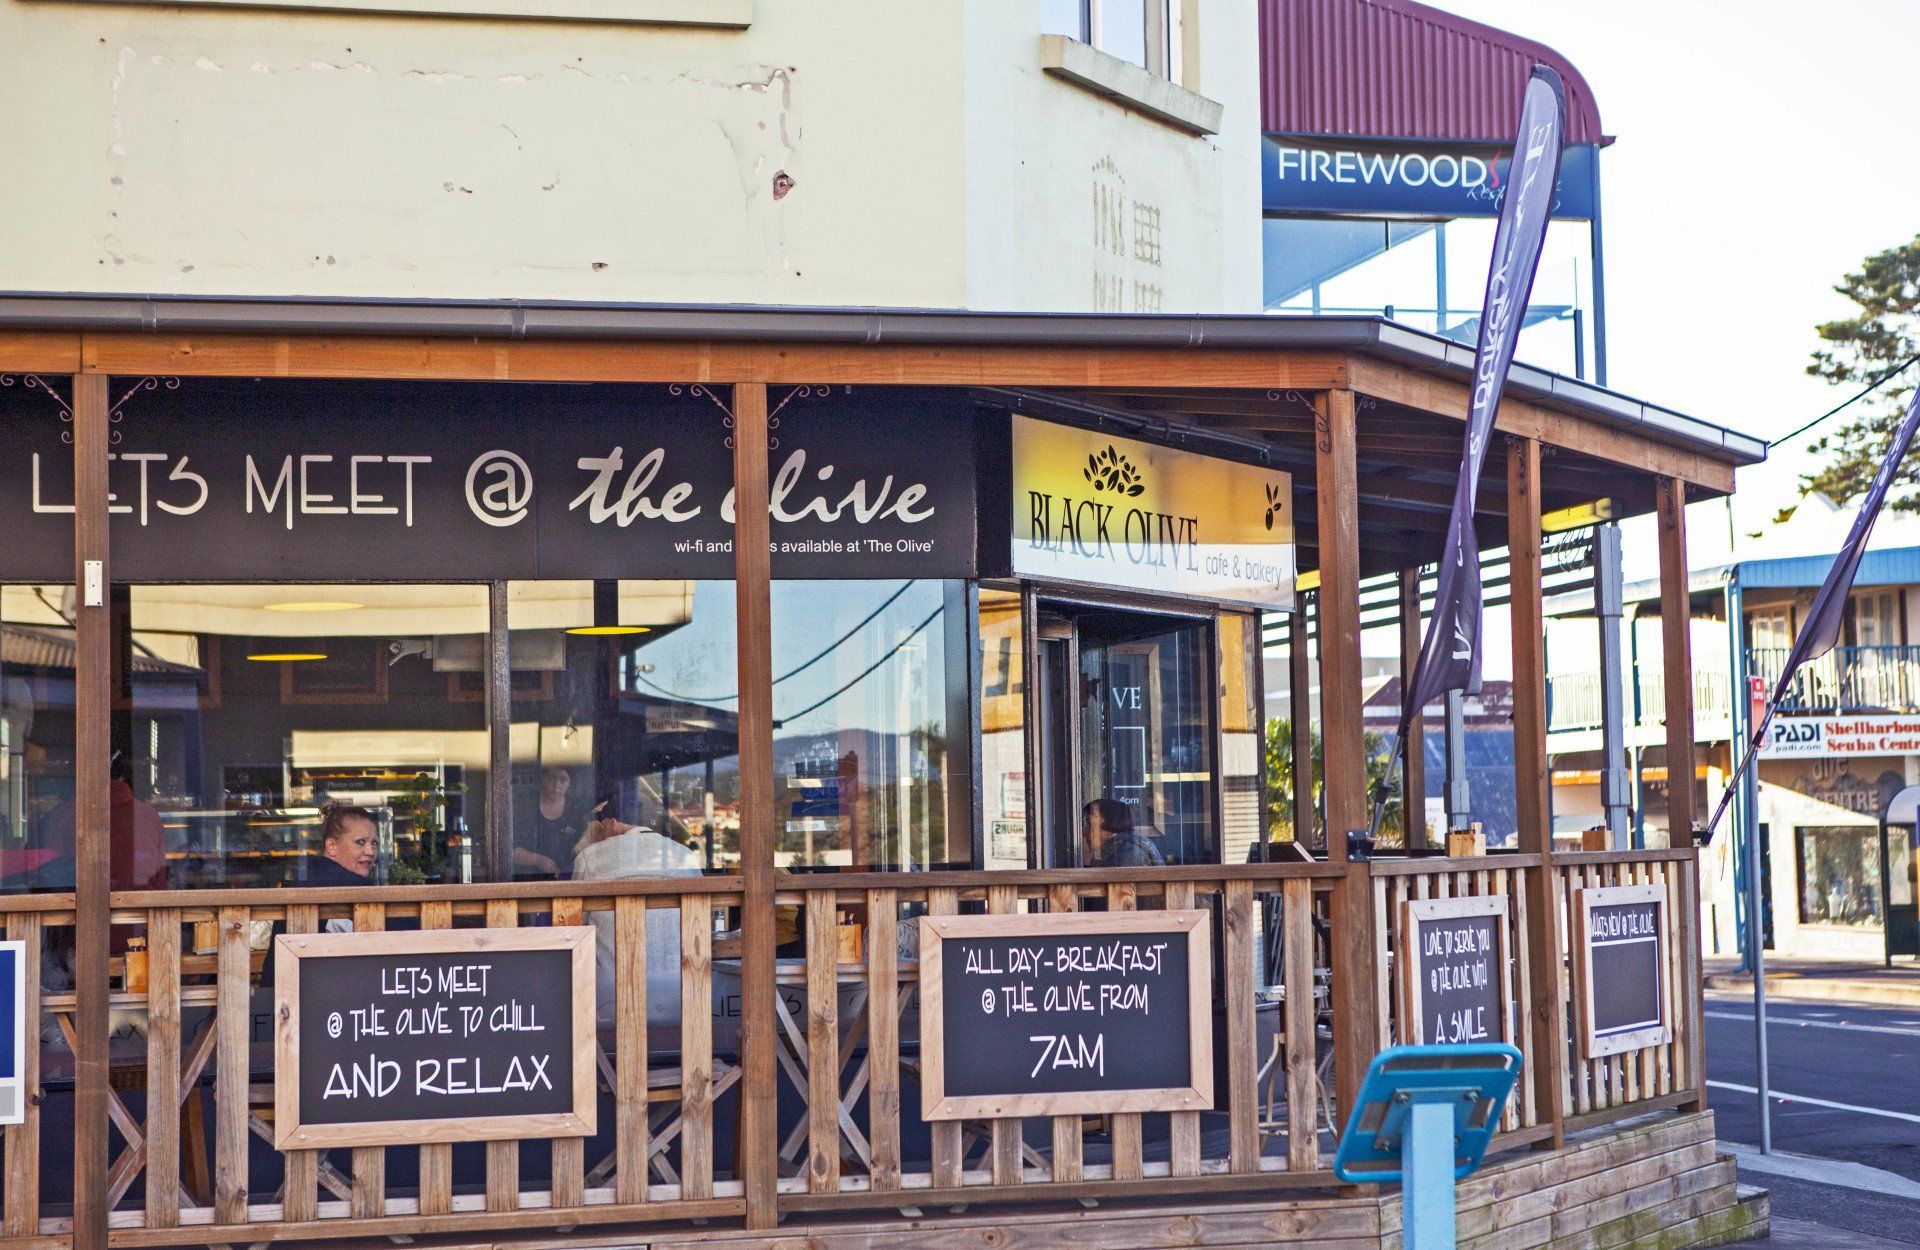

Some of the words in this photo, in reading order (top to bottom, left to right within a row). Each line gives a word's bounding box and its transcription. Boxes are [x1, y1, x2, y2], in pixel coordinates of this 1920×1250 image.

[246, 454, 432, 529] MEET
[465, 449, 533, 527] @
[569, 446, 700, 527] the
[674, 539, 703, 553] wi-fi
[706, 540, 732, 553] and
[781, 539, 842, 553] available
[846, 541, 860, 553] at
[1028, 491, 1116, 561] BLACK
[1124, 508, 1199, 575] OLIVE
[1205, 552, 1229, 577] cafe
[1232, 555, 1242, 578] &
[1245, 554, 1282, 590] bakery
[1774, 723, 1821, 743] PADI
[1827, 739, 1876, 751] Scuba
[1424, 926, 1444, 956] LOVE
[1443, 930, 1453, 958] TO
[1454, 925, 1477, 954] SERVE
[1476, 928, 1490, 956] YOU
[381, 967, 433, 999] LETS
[438, 965, 492, 999] MEET
[1437, 961, 1453, 995] THE
[981, 988, 996, 1014] @
[1002, 980, 1038, 1018] THE
[1043, 980, 1095, 1012] OLIVE
[1100, 984, 1149, 1016] FROM
[327, 1011, 343, 1039] @
[349, 1003, 390, 1042] THE
[395, 1001, 453, 1035] OLIVE
[459, 1004, 484, 1038] TO
[490, 998, 546, 1033] CHILL
[1435, 1013, 1446, 1045] A
[1449, 1006, 1488, 1045] SMILE
[1029, 1033, 1104, 1079] 7AM
[323, 1053, 402, 1100] AND
[415, 1054, 553, 1096] RELAX
